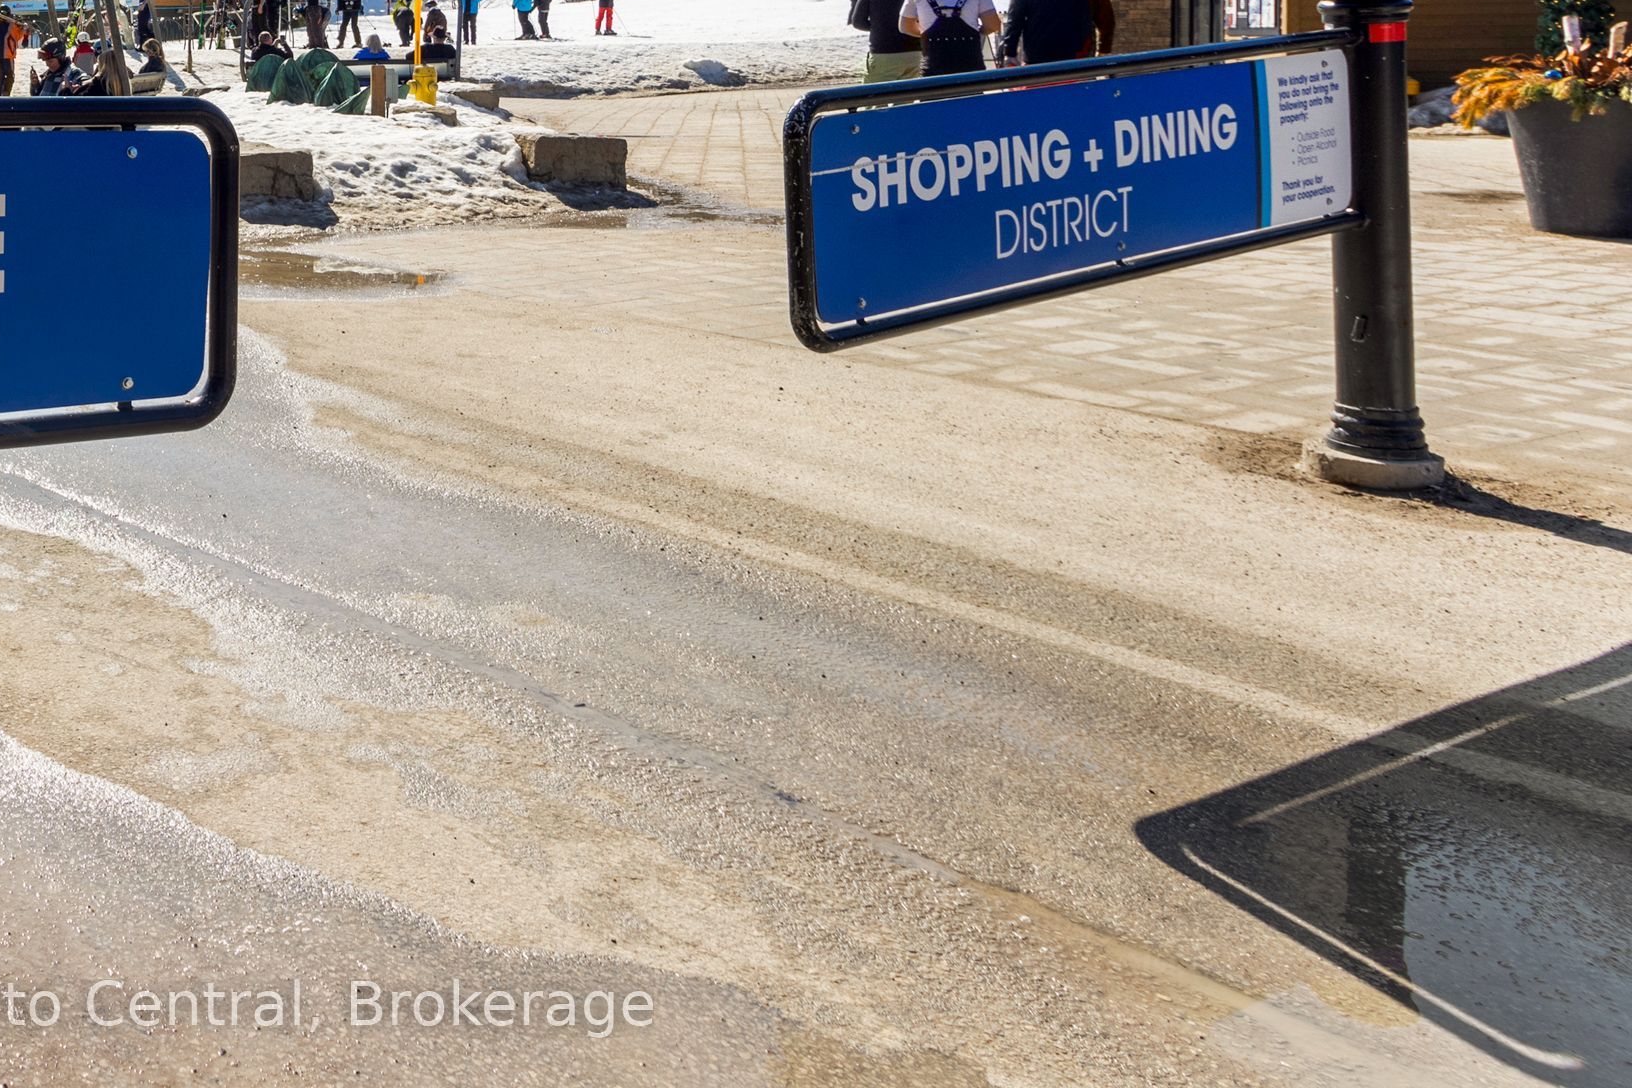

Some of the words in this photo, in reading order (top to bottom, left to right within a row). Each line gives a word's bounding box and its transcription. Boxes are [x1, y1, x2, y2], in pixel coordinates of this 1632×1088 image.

[1277, 77, 1288, 86] We
[1289, 74, 1308, 85] kindly
[1309, 72, 1320, 82] ask
[1321, 70, 1333, 80] that
[1279, 91, 1290, 101] you
[1292, 88, 1300, 97] do
[1301, 86, 1311, 95] not
[1313, 84, 1329, 95] bring
[1330, 82, 1339, 91] the
[1279, 100, 1307, 111] following
[1309, 97, 1322, 107] onto
[1323, 95, 1333, 104] the
[851, 129, 1071, 212] SHOPPING
[1114, 103, 1237, 168] DINING
[1282, 178, 1301, 191] Thank
[1303, 178, 1314, 189] you
[1315, 175, 1323, 184] for
[1282, 193, 1296, 206] your
[995, 186, 1133, 260] DISTRICT
